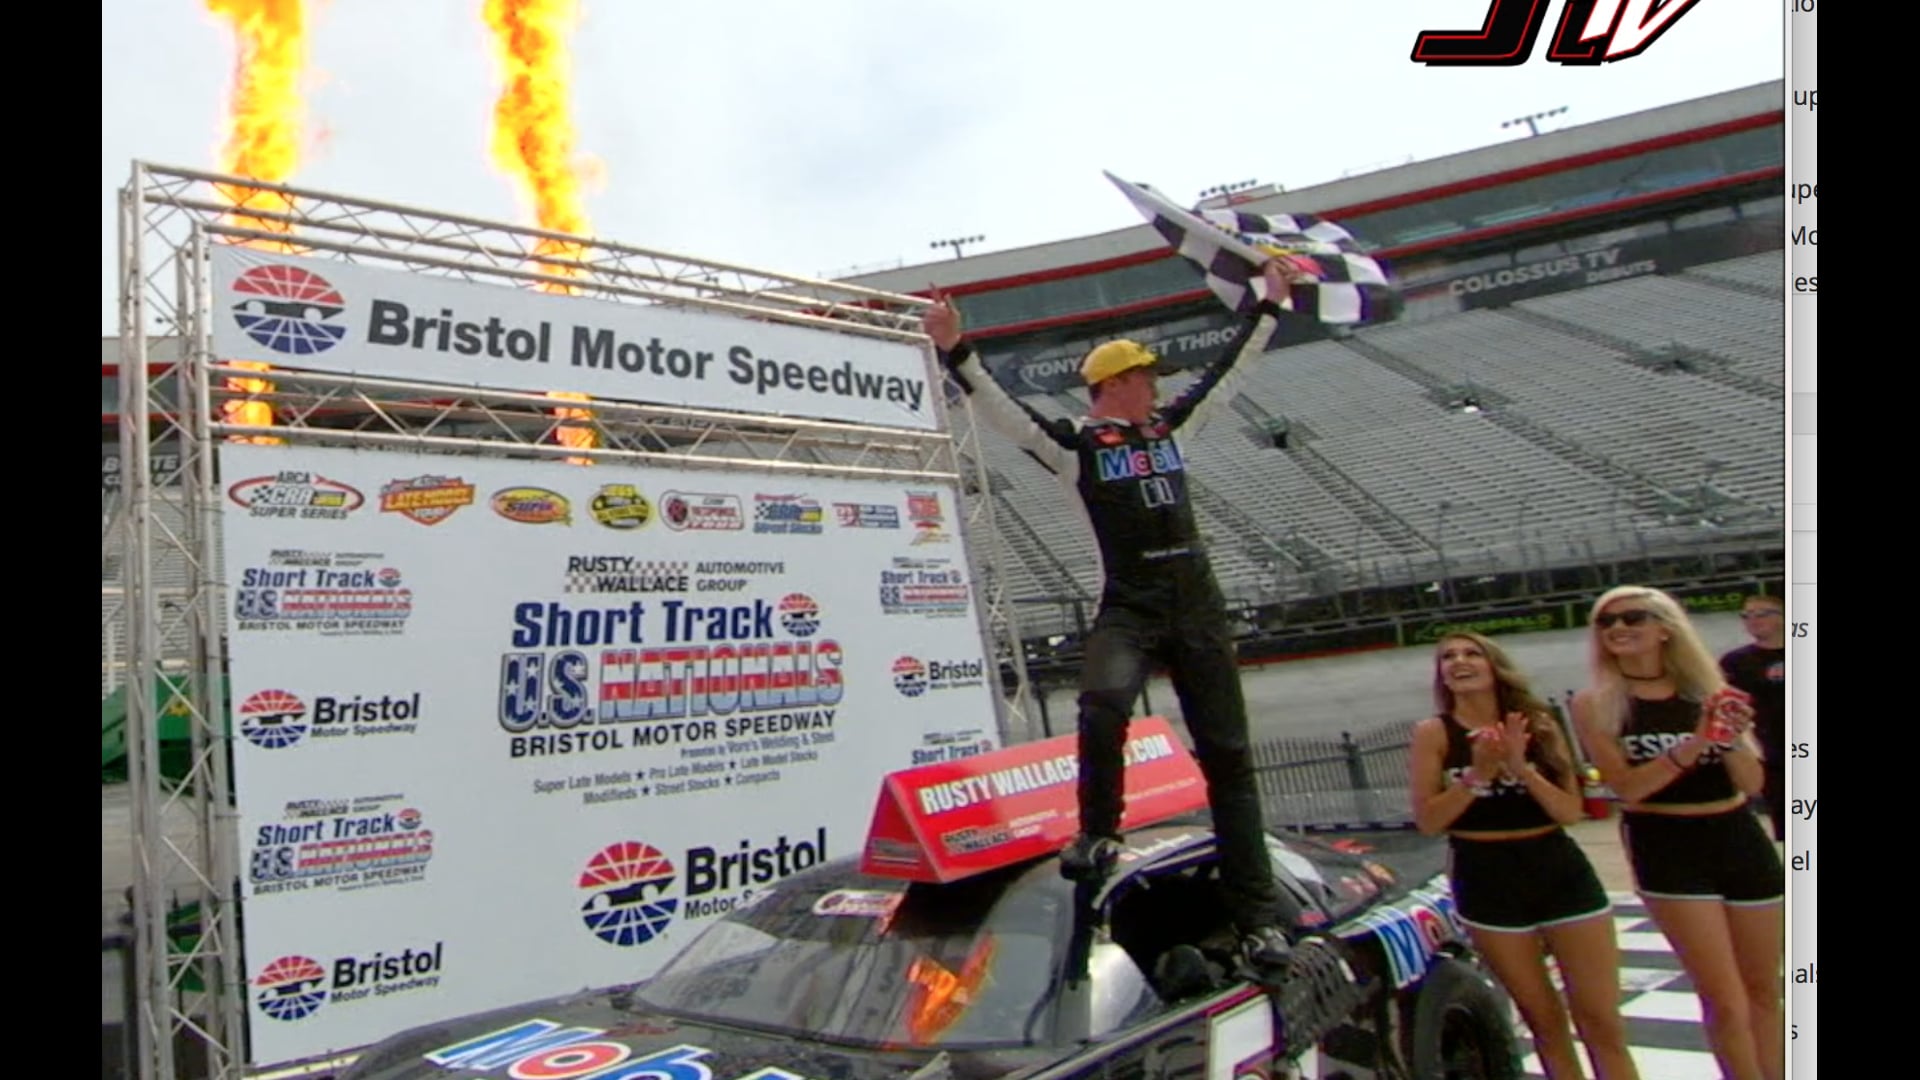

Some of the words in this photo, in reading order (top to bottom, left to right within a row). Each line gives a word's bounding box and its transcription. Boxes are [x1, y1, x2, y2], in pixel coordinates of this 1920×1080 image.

[1450, 256, 1581, 296] COLOSSUS
[1586, 248, 1622, 268] TV
[367, 299, 550, 362] Bristol
[571, 326, 713, 379] Motor
[728, 346, 924, 410] Speedway
[1025, 357, 1081, 378] TONY
[276, 471, 310, 483] ARCA
[250, 506, 296, 518] SUPER
[299, 507, 347, 520] SERIES
[242, 568, 306, 588] Short
[316, 569, 374, 588] Track
[568, 556, 634, 573] RUSTY
[695, 561, 785, 575] AUTOMOTIVE
[597, 576, 689, 593] WALLACE
[696, 579, 747, 592] GROUP
[239, 621, 291, 631] BRISTOL
[297, 620, 339, 630] MOTOR
[344, 619, 405, 629] SPEEDWAY
[513, 601, 644, 648] Short
[662, 599, 774, 642] Track
[929, 658, 982, 680] Bristol
[498, 650, 595, 733] U.S.
[600, 639, 844, 724] NATIONALS
[313, 692, 420, 725] Bristol
[311, 726, 349, 738] Motor
[353, 723, 417, 737] Speedway
[511, 730, 623, 758] BRISTOL
[632, 722, 717, 748] MOTOR
[725, 710, 836, 738] SPEEDWAY
[534, 777, 567, 794] Super
[568, 775, 592, 790] Late
[595, 771, 632, 787] Models
[649, 763, 667, 779] Pro
[668, 761, 688, 778] Late
[692, 759, 725, 774] Models
[740, 754, 761, 769] Late
[919, 775, 993, 815] RUSTY
[257, 821, 323, 847] Short
[334, 812, 395, 838] Track
[685, 827, 826, 896] Bristol
[254, 880, 310, 895] BRISTOL
[314, 873, 359, 888] MOTOR
[363, 864, 427, 880] SPEEDWAY
[684, 896, 735, 920] Motor
[333, 941, 443, 989] Bristol
[331, 988, 369, 1004] Motor
[374, 976, 440, 996] Speedway
